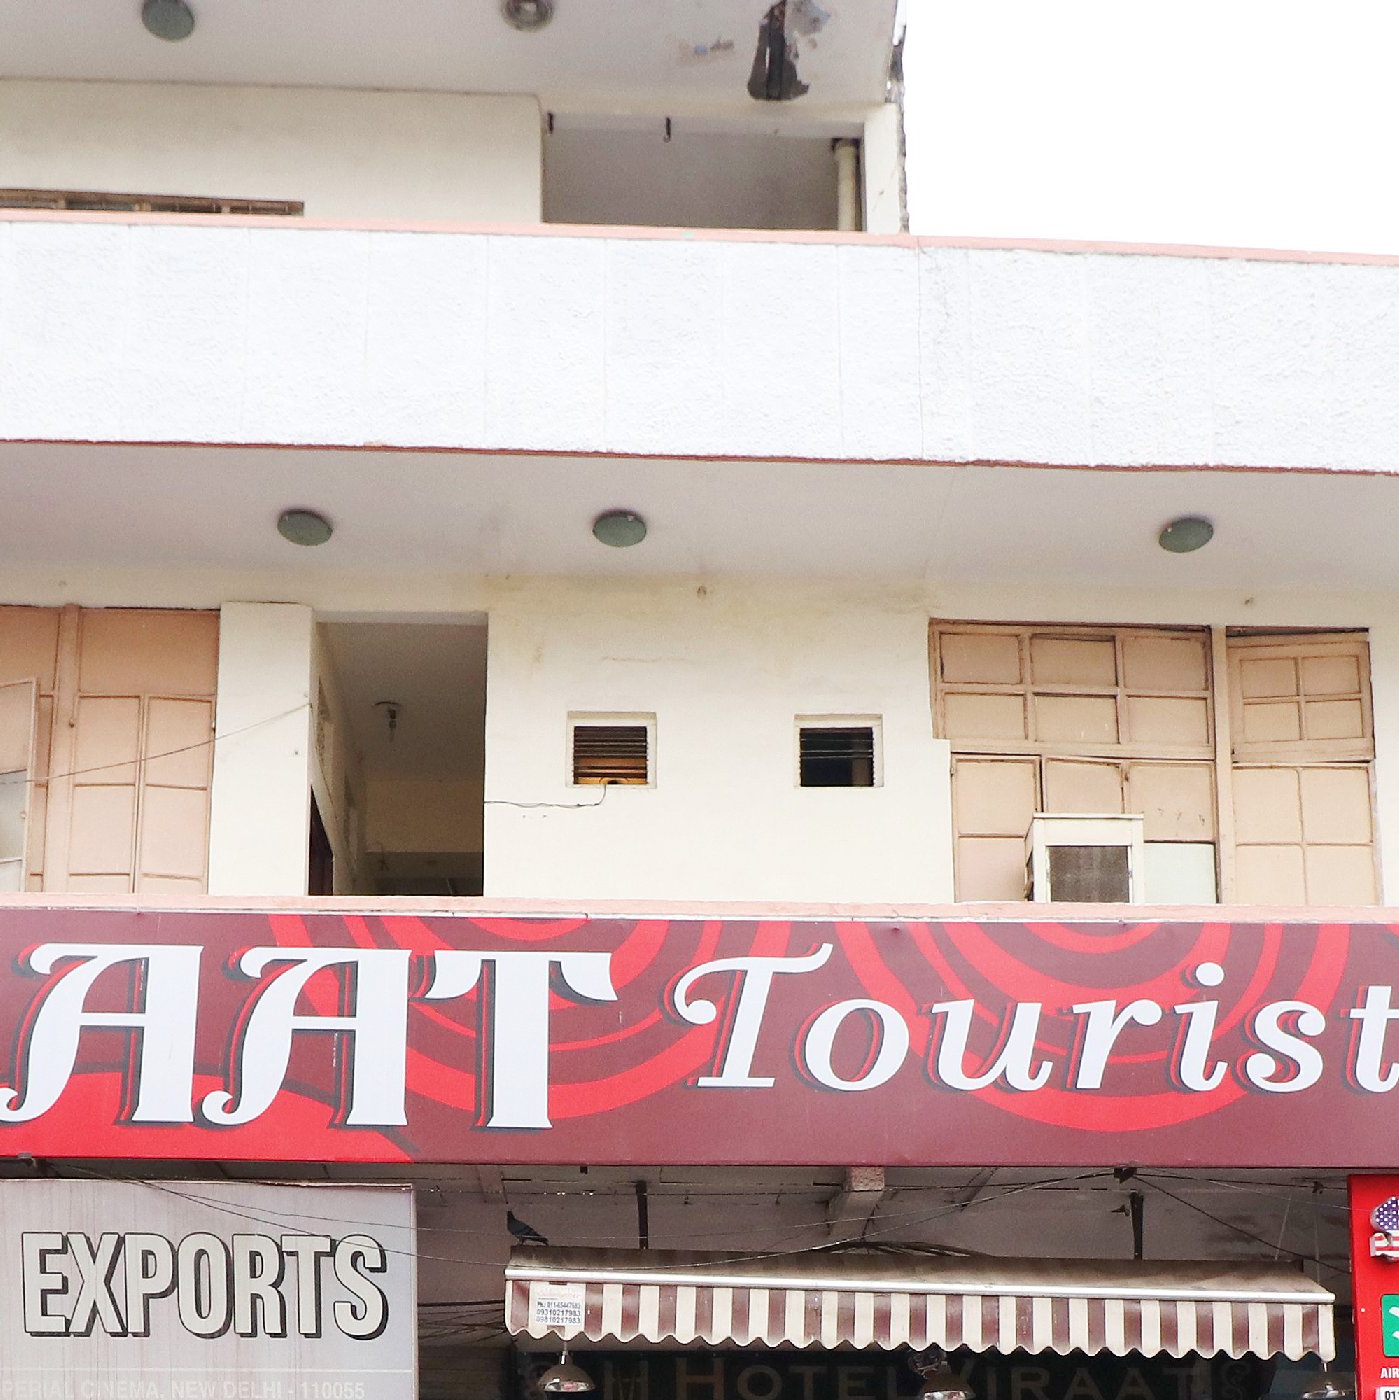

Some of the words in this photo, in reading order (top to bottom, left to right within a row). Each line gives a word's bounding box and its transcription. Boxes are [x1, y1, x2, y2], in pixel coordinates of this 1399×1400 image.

[21, 1229, 391, 1341] EXPORTS
[172, 1382, 215, 1399] NEW
[223, 1382, 282, 1399] DELHI
[300, 1381, 366, 1400] 110055
